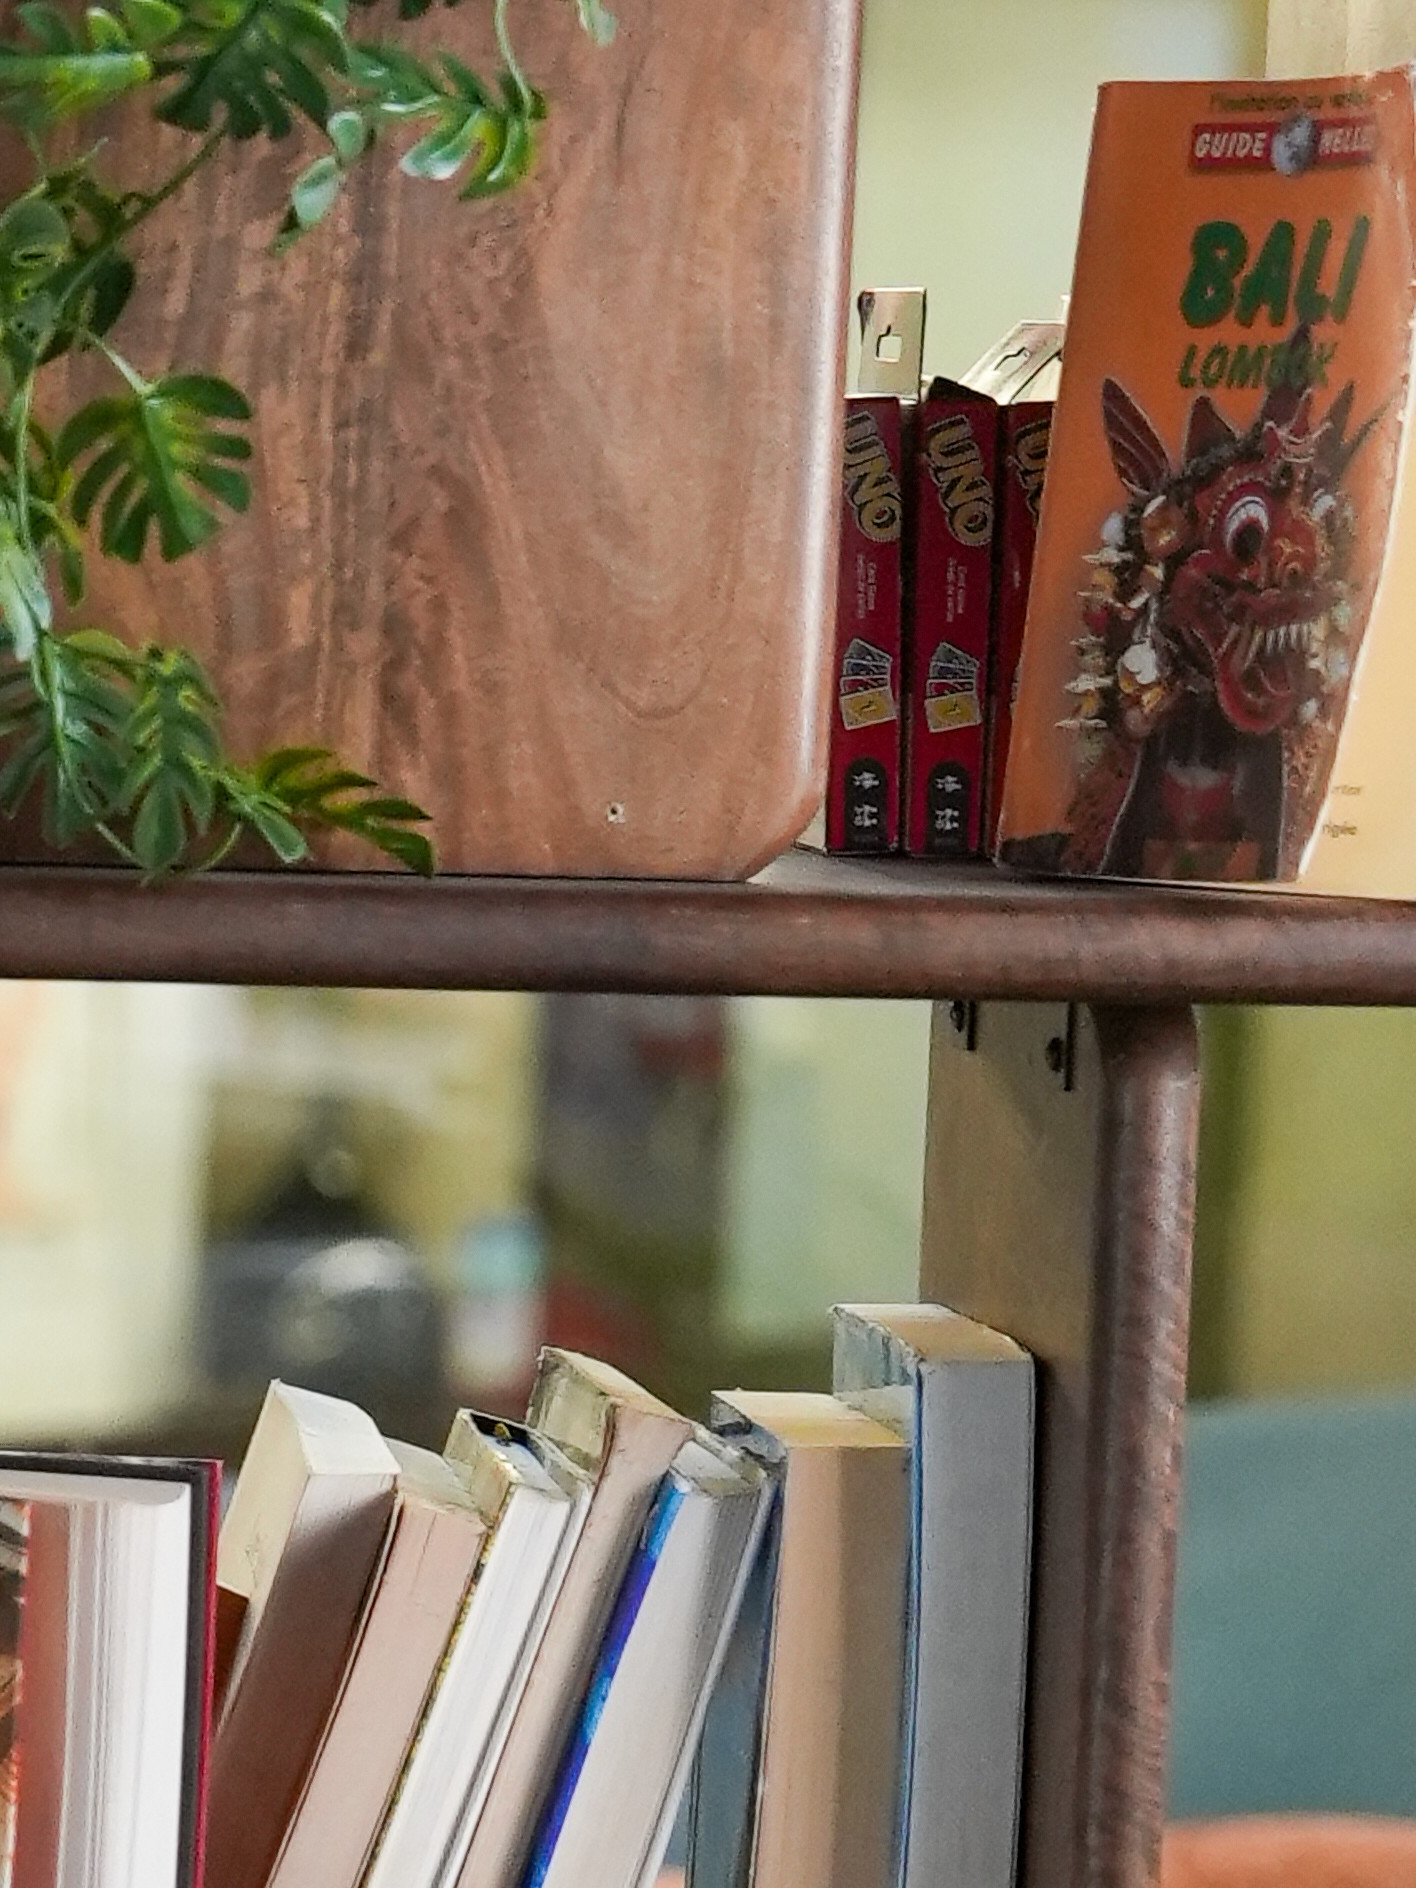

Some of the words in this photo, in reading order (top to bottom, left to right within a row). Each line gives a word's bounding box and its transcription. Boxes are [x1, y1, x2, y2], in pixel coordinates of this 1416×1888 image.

[1194, 131, 1268, 159] GUIDE
[1179, 215, 1370, 328] BALI
[843, 410, 903, 542] UNO
[925, 414, 994, 546] UNO
